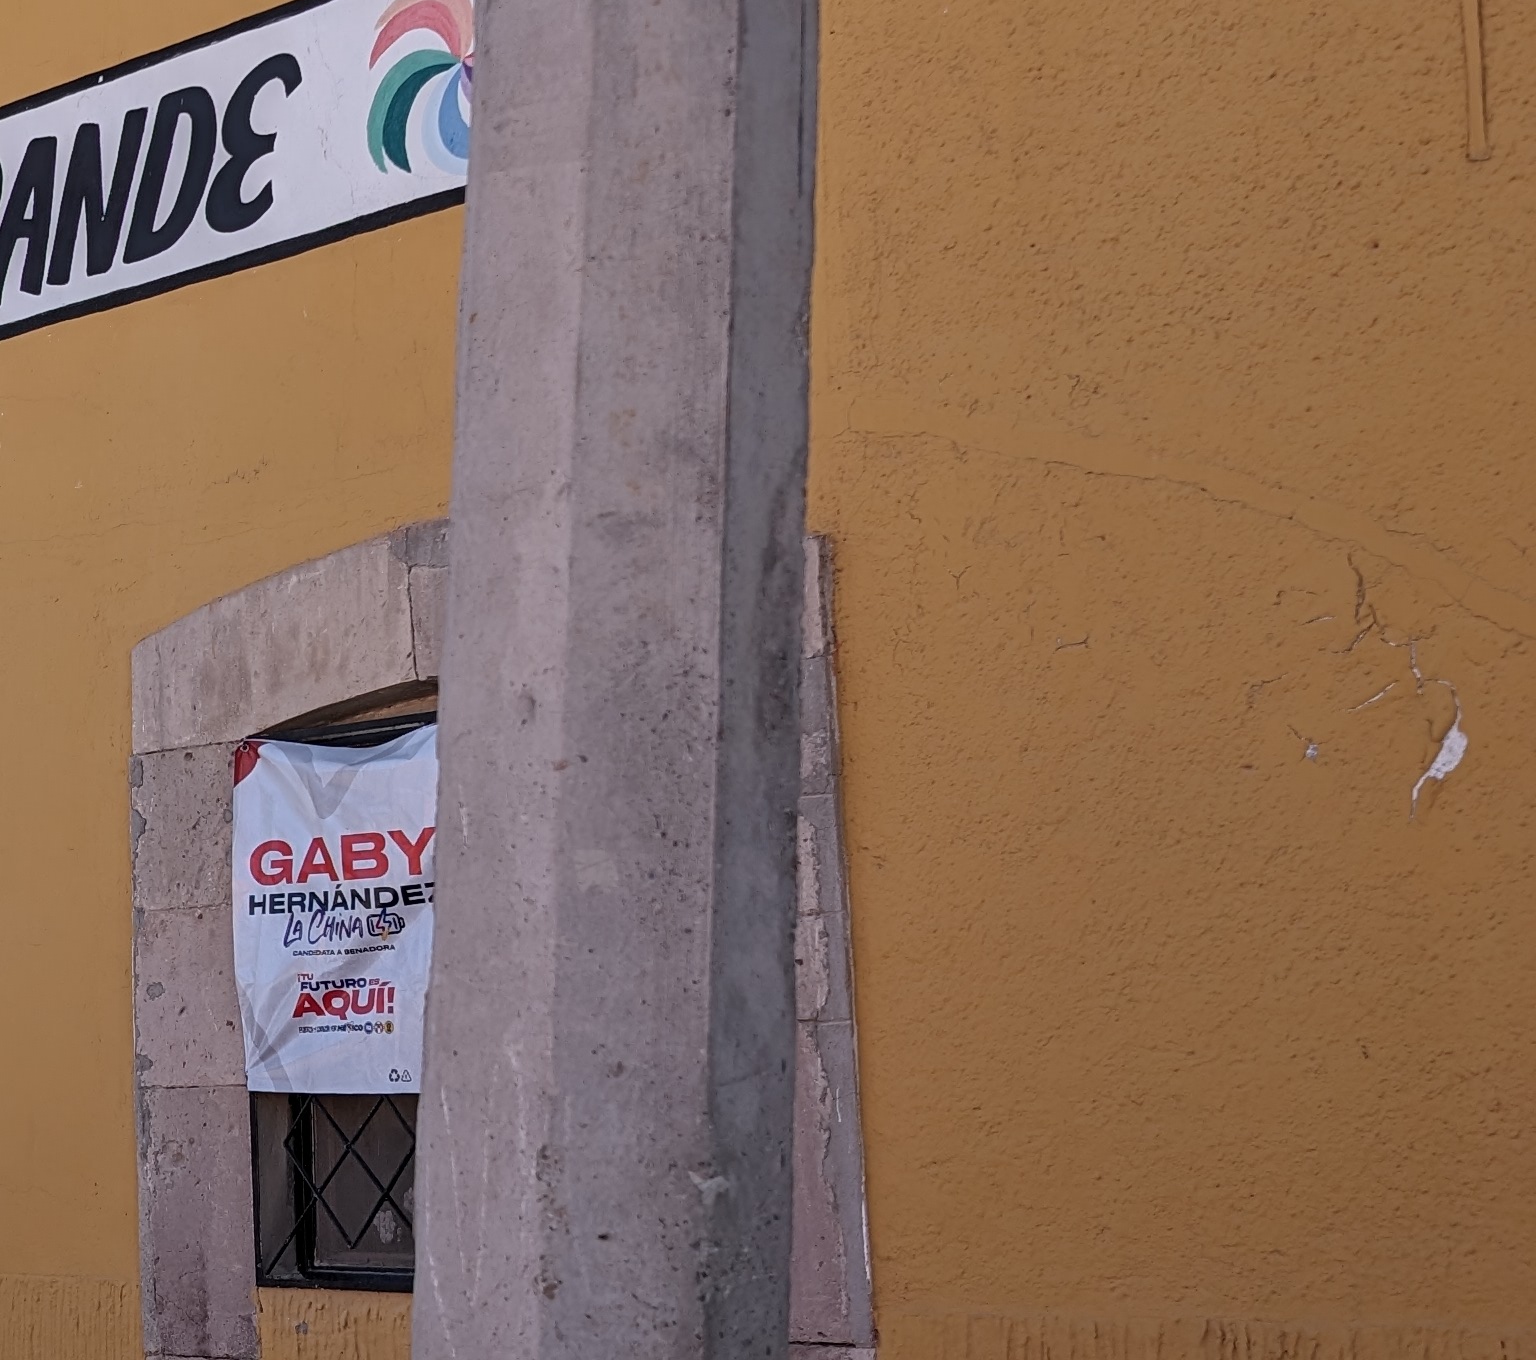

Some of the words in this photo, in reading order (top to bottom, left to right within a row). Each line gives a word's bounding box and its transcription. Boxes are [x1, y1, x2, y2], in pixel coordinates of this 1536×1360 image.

[249, 827, 437, 886] GABY
[292, 981, 395, 1020] AQUÍ!
[300, 977, 367, 992] FUTURO
